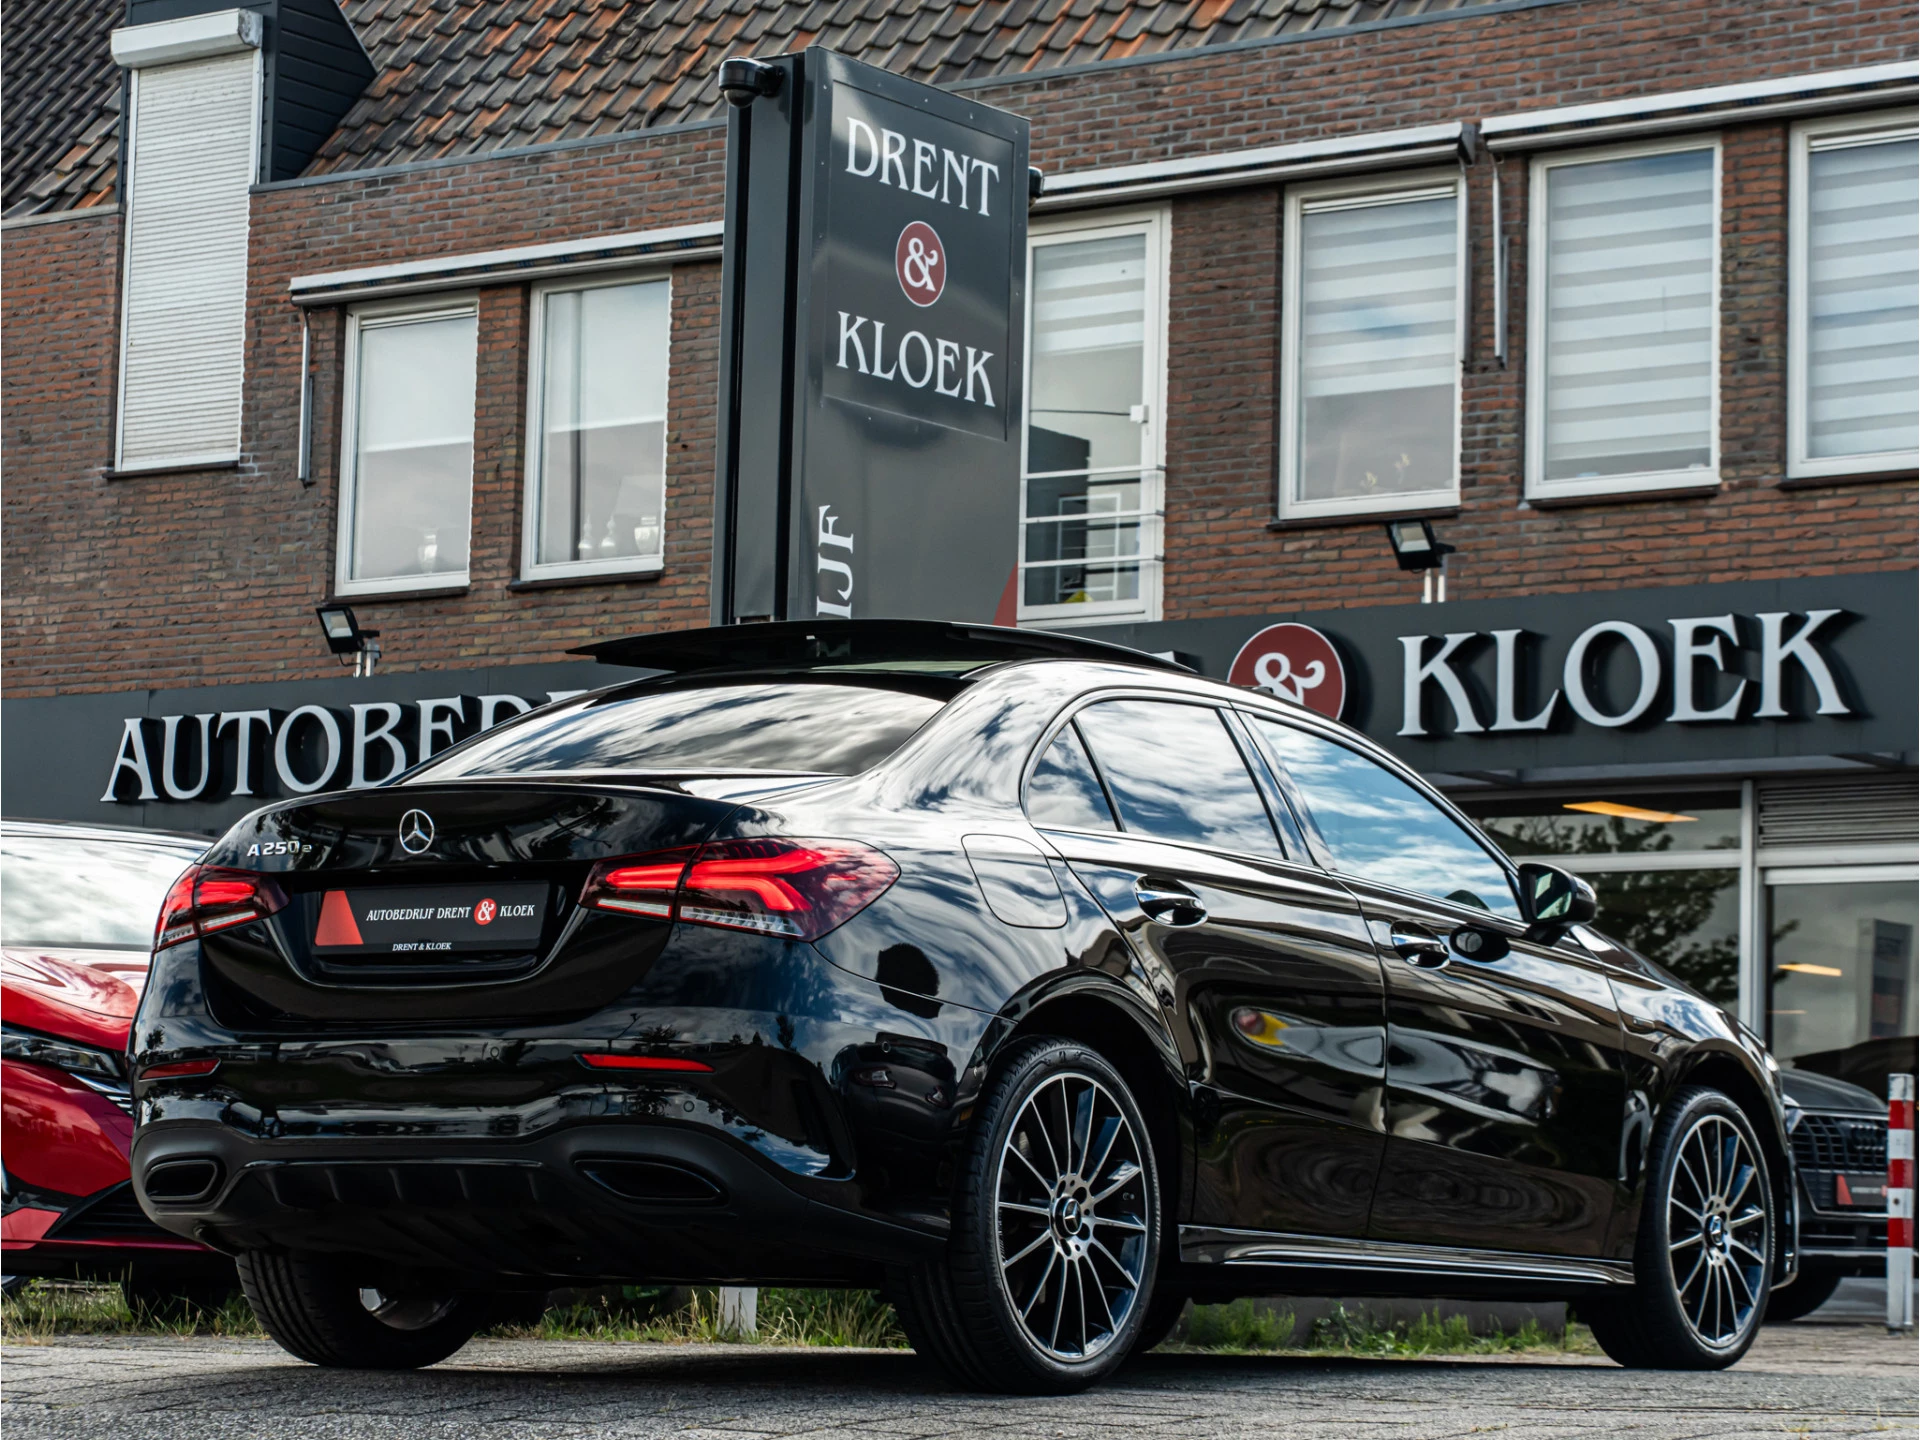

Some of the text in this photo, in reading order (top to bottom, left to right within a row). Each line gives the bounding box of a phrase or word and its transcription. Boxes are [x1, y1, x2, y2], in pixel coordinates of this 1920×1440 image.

[845, 116, 999, 216] DRENT
[904, 237, 938, 292] &
[836, 310, 996, 408] KLOEK
[1397, 608, 1852, 737] KLOEK
[366, 901, 535, 921] AUTOBEDRIJF DRENT & KLOEK
[392, 943, 419, 951] DRENT
[425, 942, 452, 950] KLOEK
